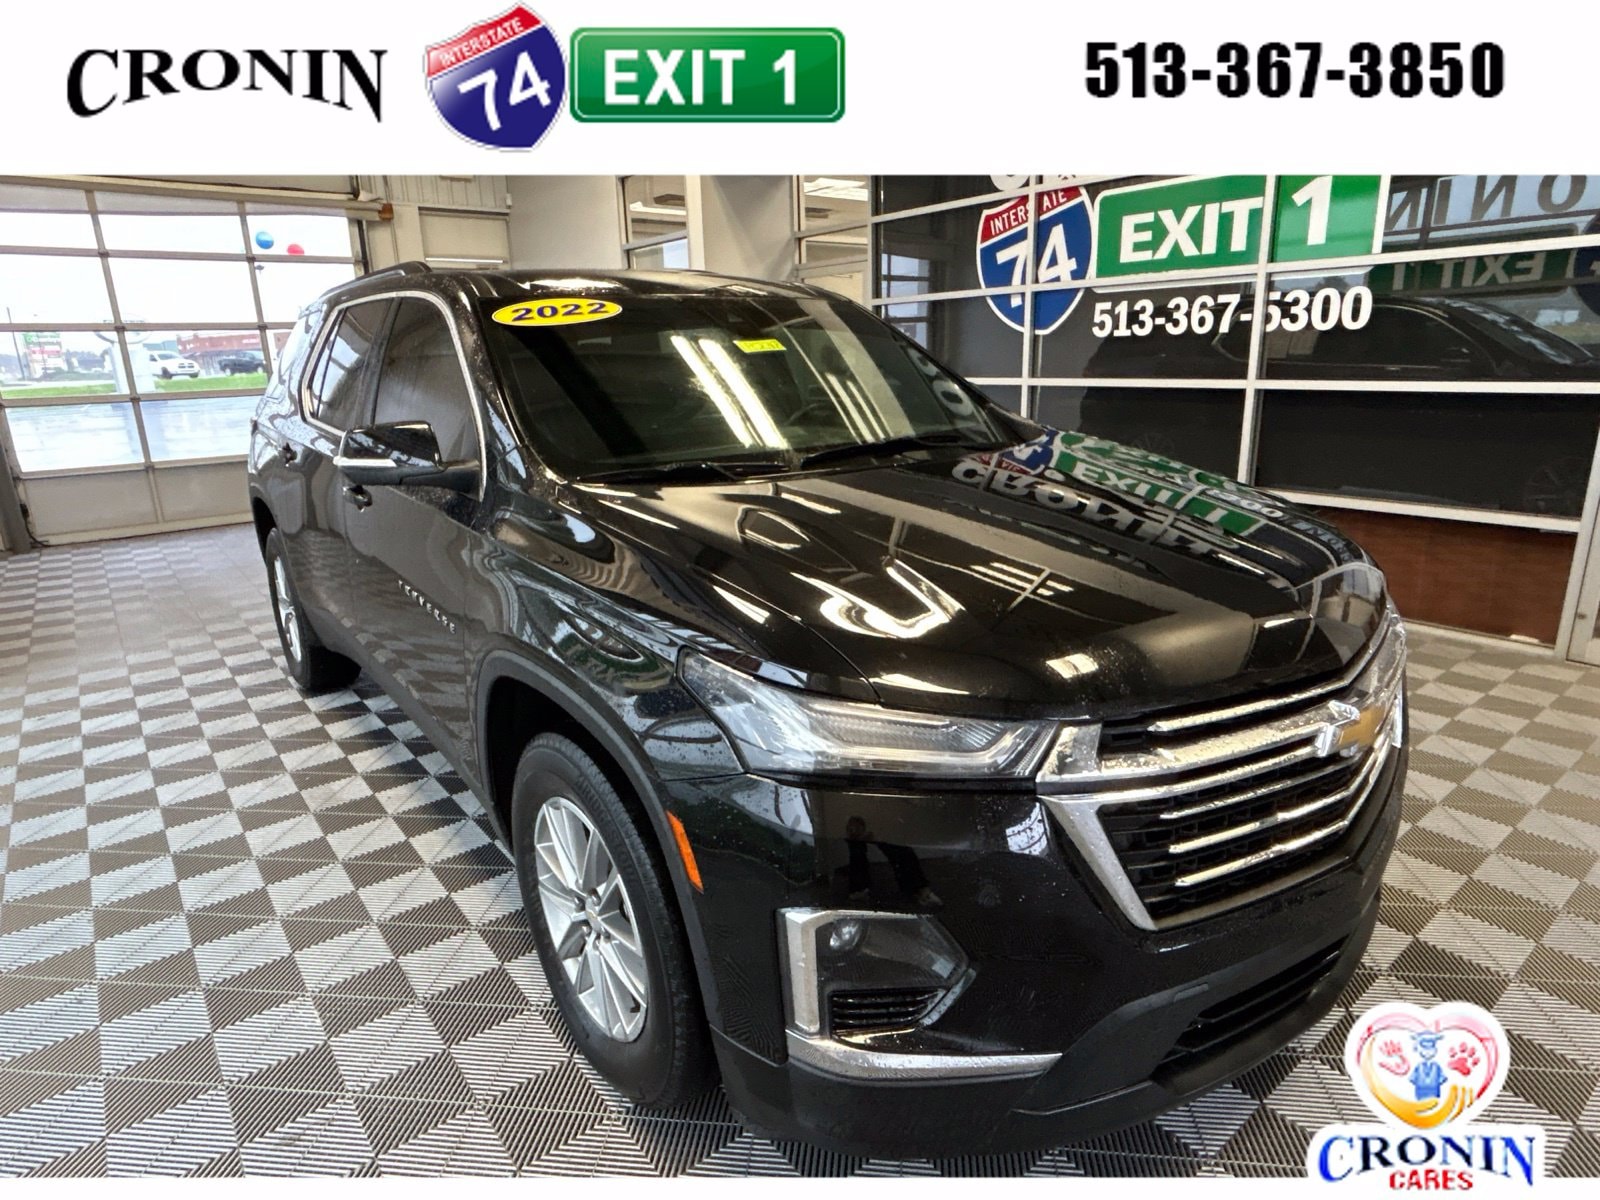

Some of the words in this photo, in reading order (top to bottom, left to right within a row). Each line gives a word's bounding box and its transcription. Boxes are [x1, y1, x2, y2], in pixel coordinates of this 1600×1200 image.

[1119, 196, 1264, 263] EXIT
[1291, 175, 1332, 246] 1
[996, 223, 1077, 308] 74
[511, 302, 609, 322] 2022
[1092, 286, 1372, 337] 513-367-5300
